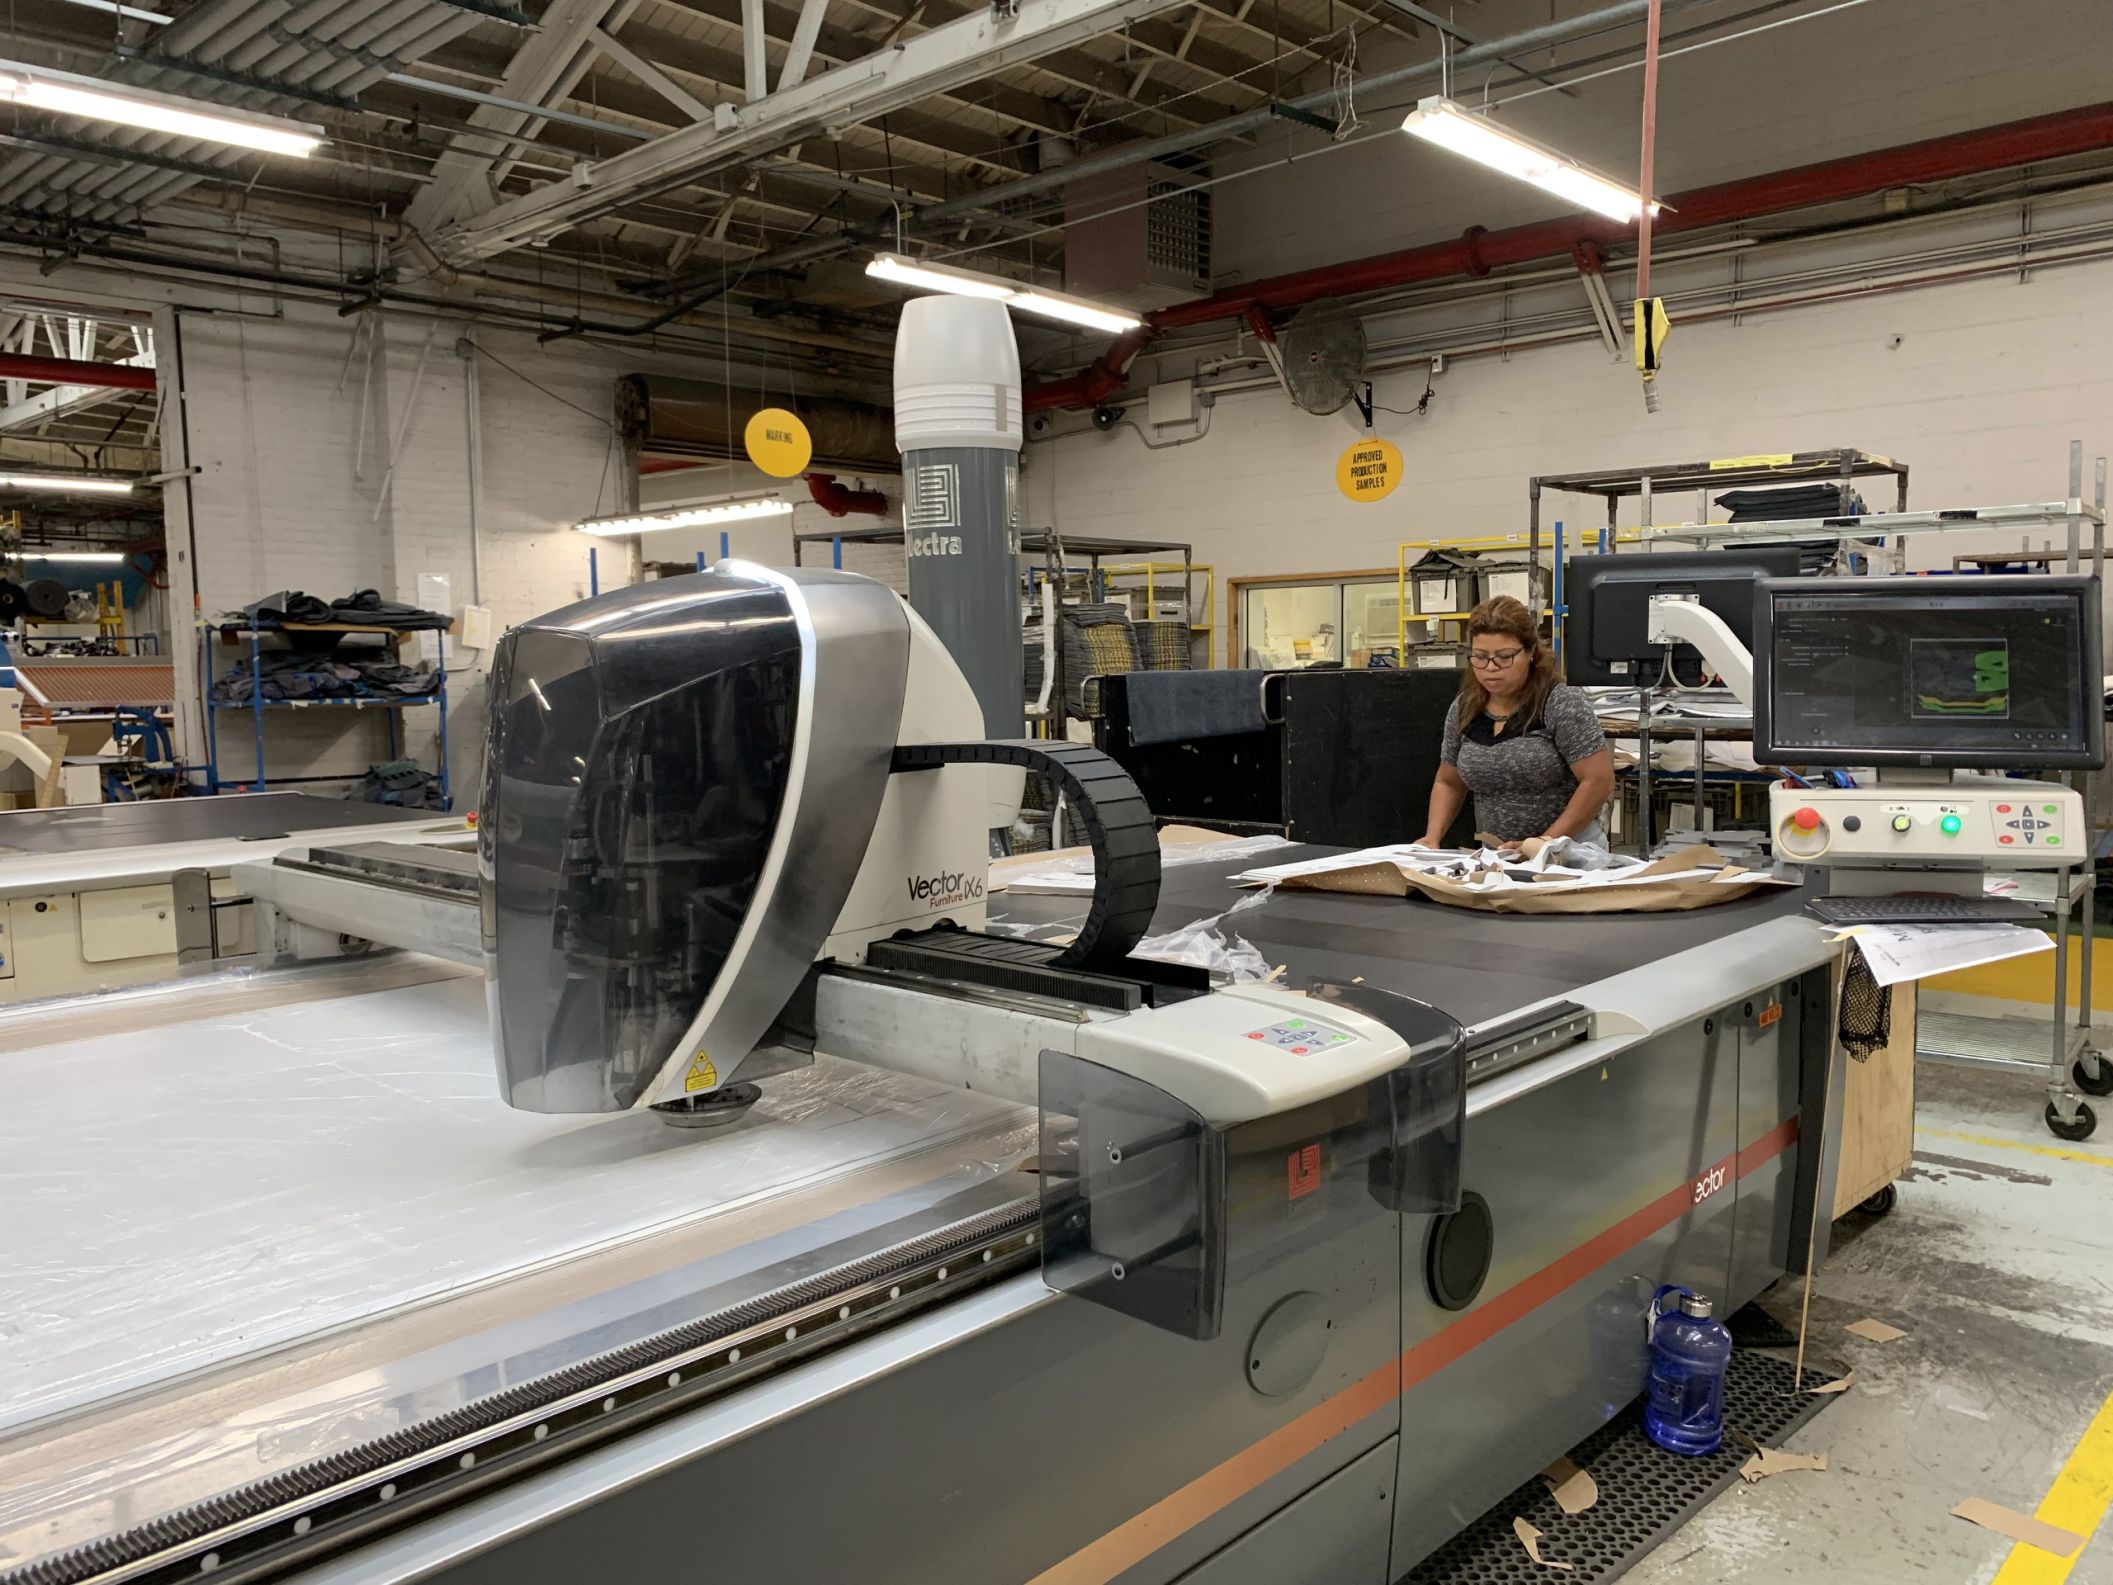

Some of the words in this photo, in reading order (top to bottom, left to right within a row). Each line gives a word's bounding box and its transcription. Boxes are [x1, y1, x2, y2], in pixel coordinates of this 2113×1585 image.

[766, 428, 793, 444] MARKING
[1352, 449, 1383, 464] APPROVED
[1351, 462, 1387, 478] PRODUCTION
[1356, 476, 1385, 491] SAMPLES
[908, 870, 964, 901] Vector
[929, 893, 964, 909] Furniture
